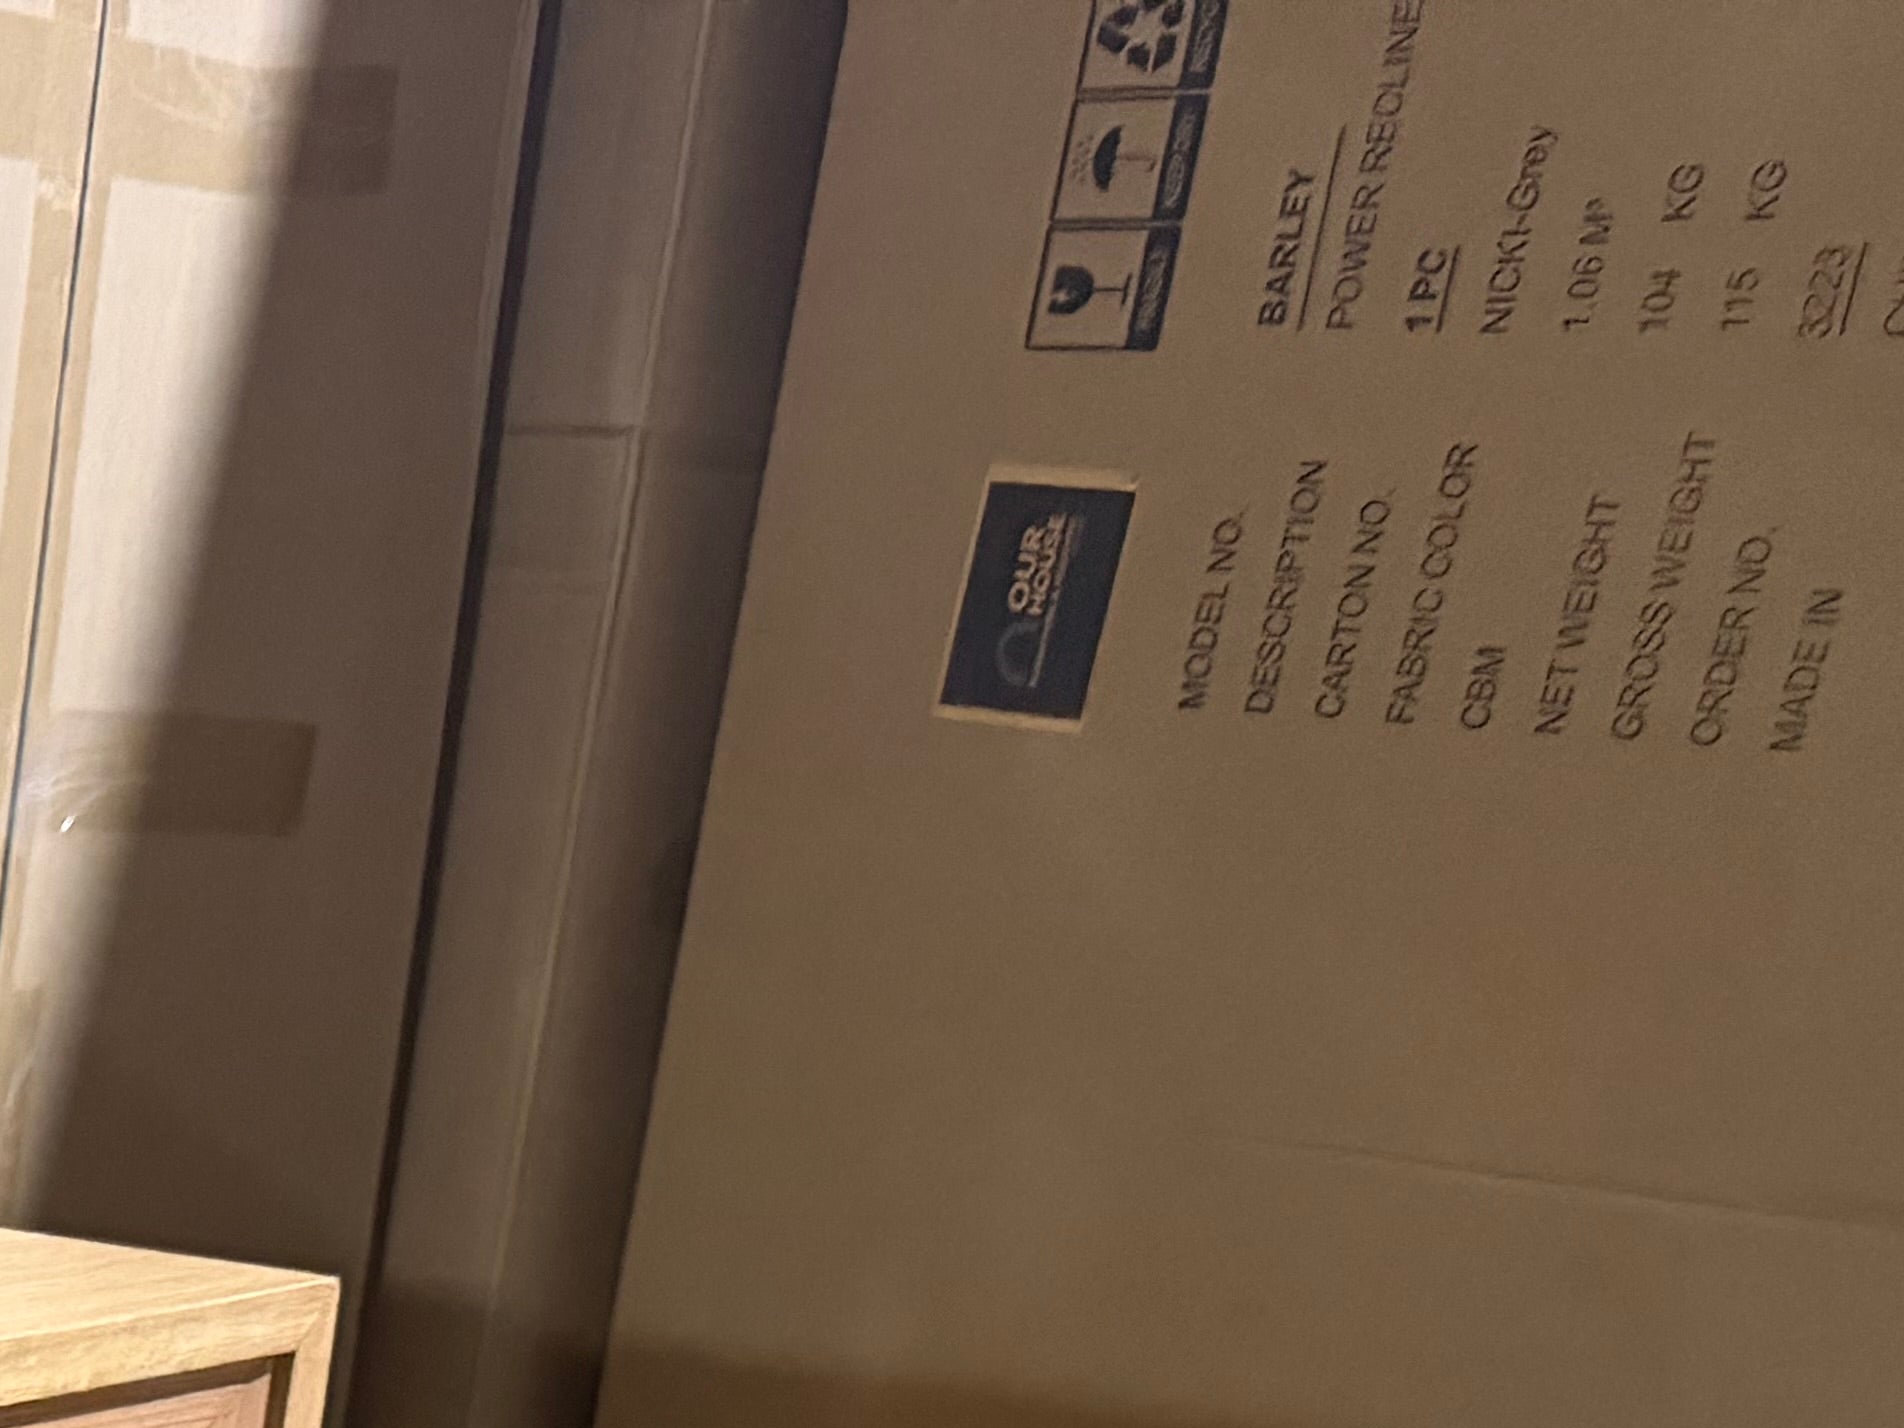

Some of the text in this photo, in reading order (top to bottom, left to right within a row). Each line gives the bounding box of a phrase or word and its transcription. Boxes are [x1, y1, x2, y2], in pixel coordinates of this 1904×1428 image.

[1256, 166, 1314, 326] BARLEY
[1325, 182, 1384, 329] POWER
[1403, 247, 1447, 332] 1 PC
[1638, 161, 1706, 333] 104 KG
[1719, 158, 1789, 331] 115 KG
[1007, 524, 1049, 612] OUR
[1177, 508, 1245, 709] MODEL NO.
[1244, 458, 1328, 714] DESCRIPTION
[1314, 562, 1376, 718] CARTON
[1385, 442, 1479, 724] FABRIC COLOR
[1533, 493, 1620, 734] NET WEIGHT
[1610, 430, 1716, 739] GROSS WEIGHT
[1690, 525, 1778, 745] ORDER NO.
[1460, 644, 1505, 729] CBM
[1768, 586, 1843, 750] MADE IN
